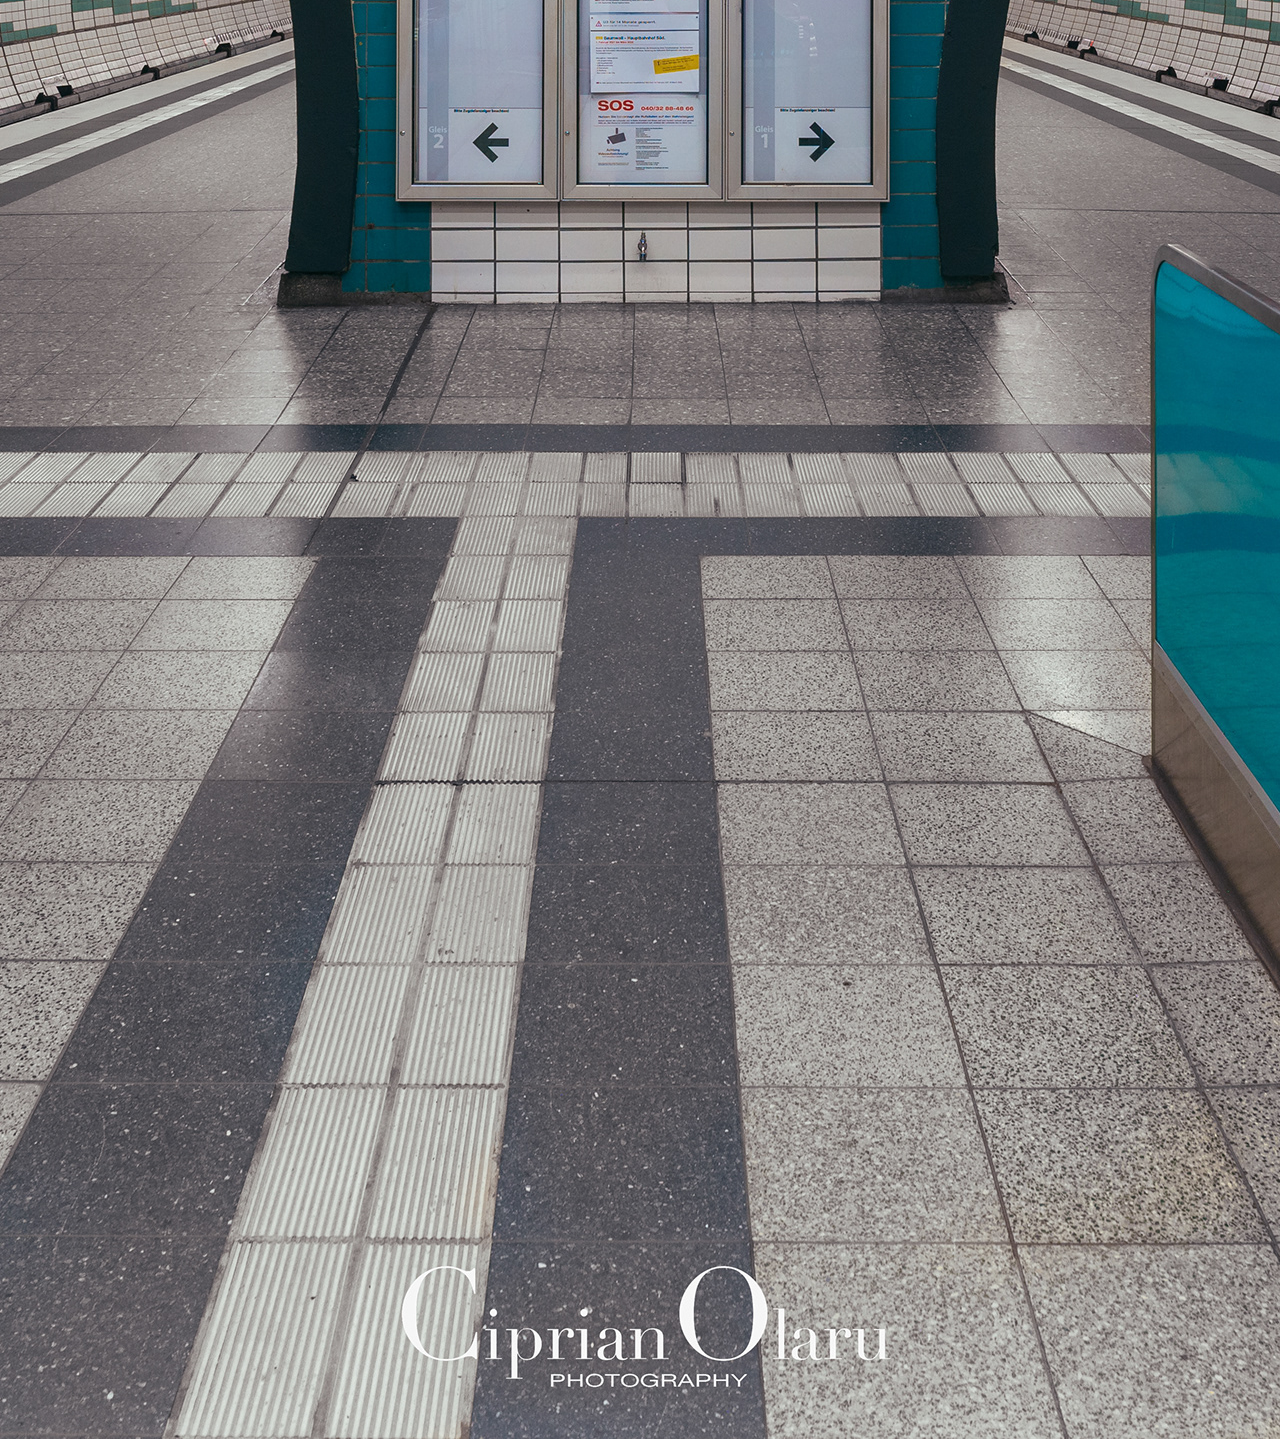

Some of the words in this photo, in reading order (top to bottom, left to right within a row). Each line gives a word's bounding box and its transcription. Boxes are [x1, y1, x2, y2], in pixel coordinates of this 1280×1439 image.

[598, 99, 634, 112] SOS
[755, 125, 773, 133] Gleis
[433, 134, 444, 149] 2
[761, 134, 768, 148] 1
